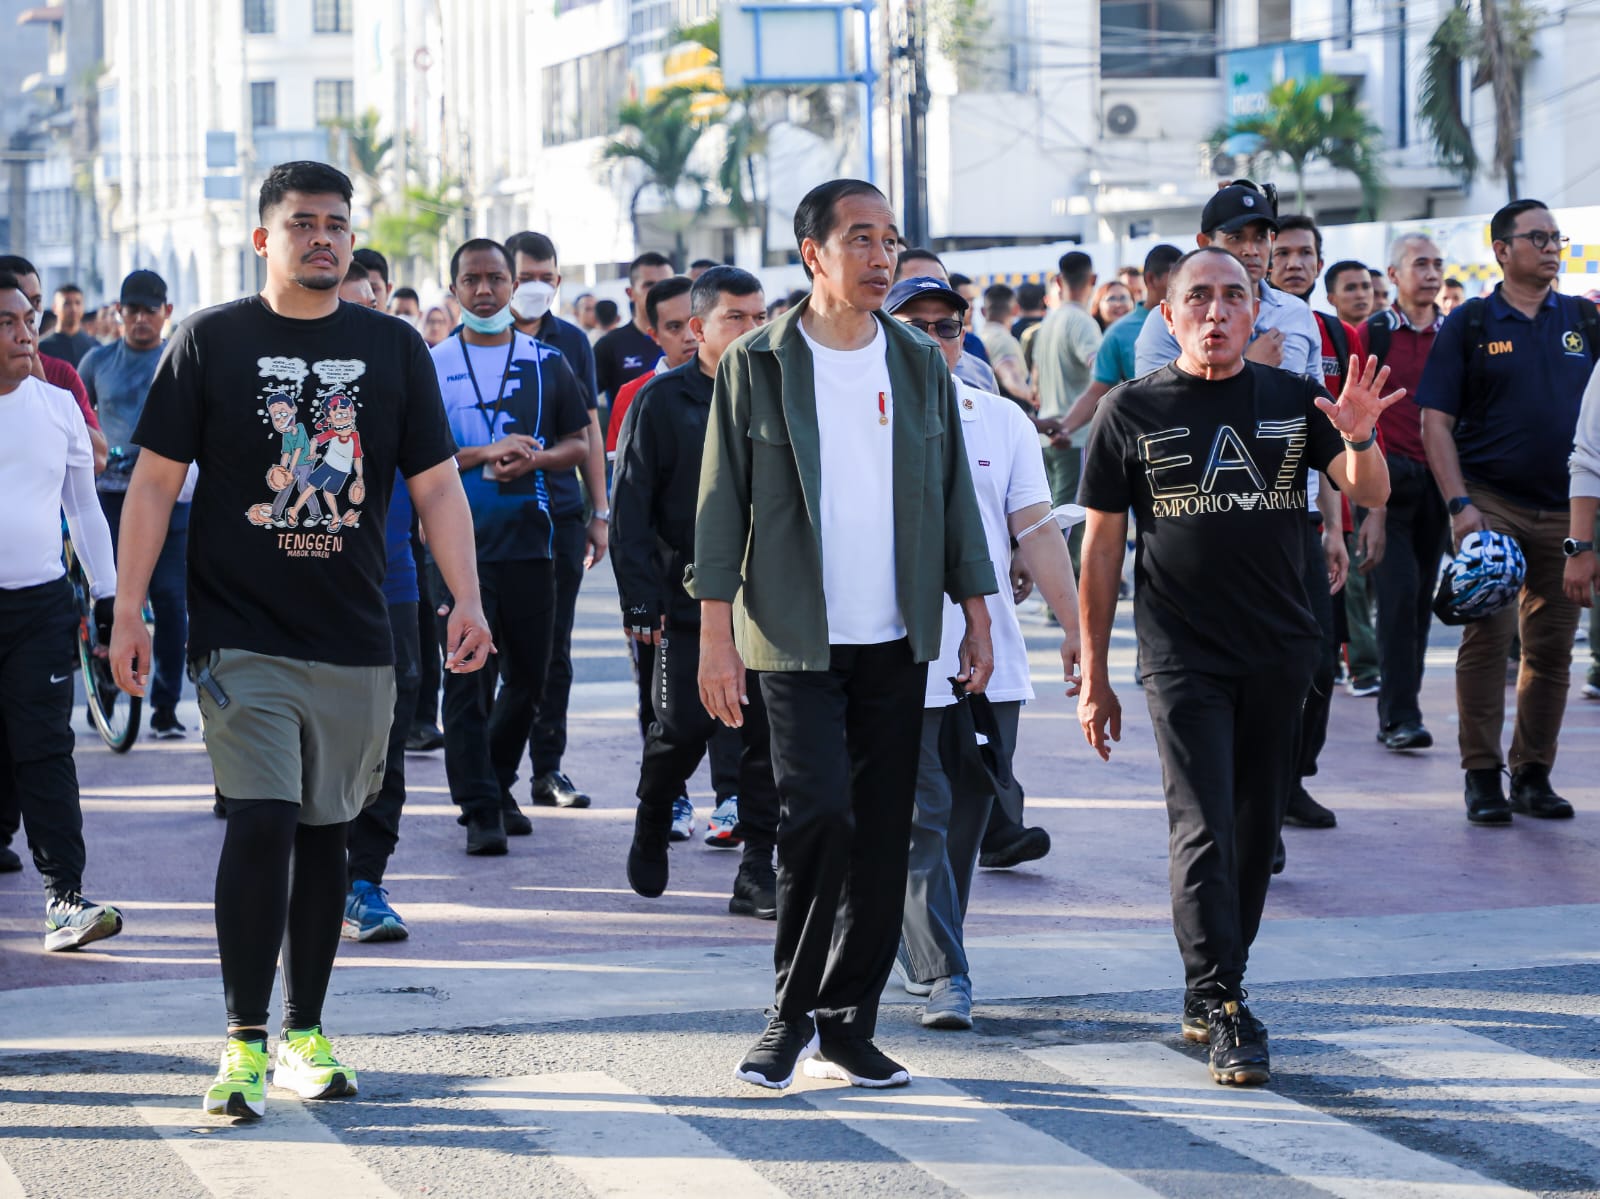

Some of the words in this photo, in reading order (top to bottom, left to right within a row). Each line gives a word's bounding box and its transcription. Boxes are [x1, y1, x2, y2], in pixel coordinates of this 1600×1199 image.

[1488, 340, 1513, 355] OM
[1137, 416, 1307, 500] EA7
[1152, 494, 1233, 517] EMPORIO
[1259, 490, 1307, 510] ARMAN
[277, 533, 343, 552] TENGGEN
